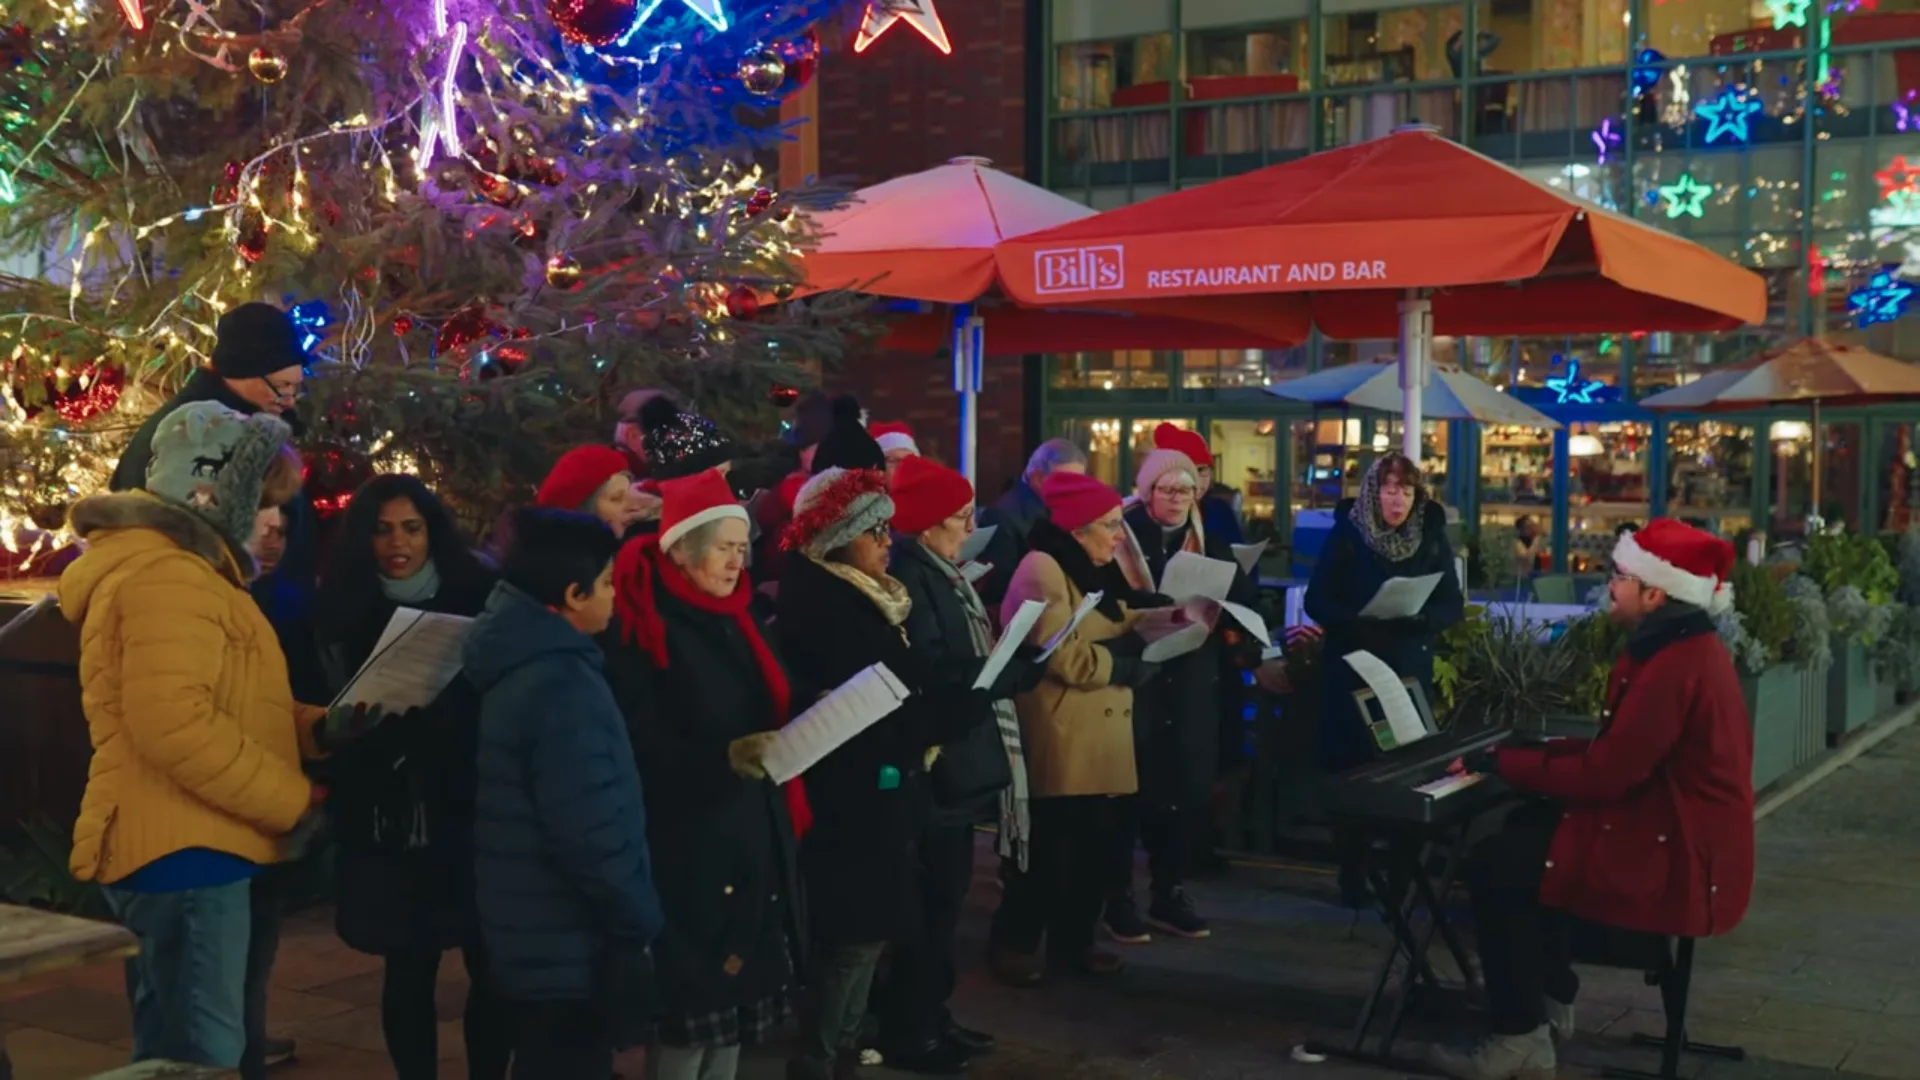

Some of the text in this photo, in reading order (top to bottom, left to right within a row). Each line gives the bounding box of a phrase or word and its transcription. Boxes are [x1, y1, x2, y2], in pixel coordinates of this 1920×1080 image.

[1044, 248, 1117, 290] Bill's
[1147, 260, 1387, 288] RESTAURANT AND BAR
